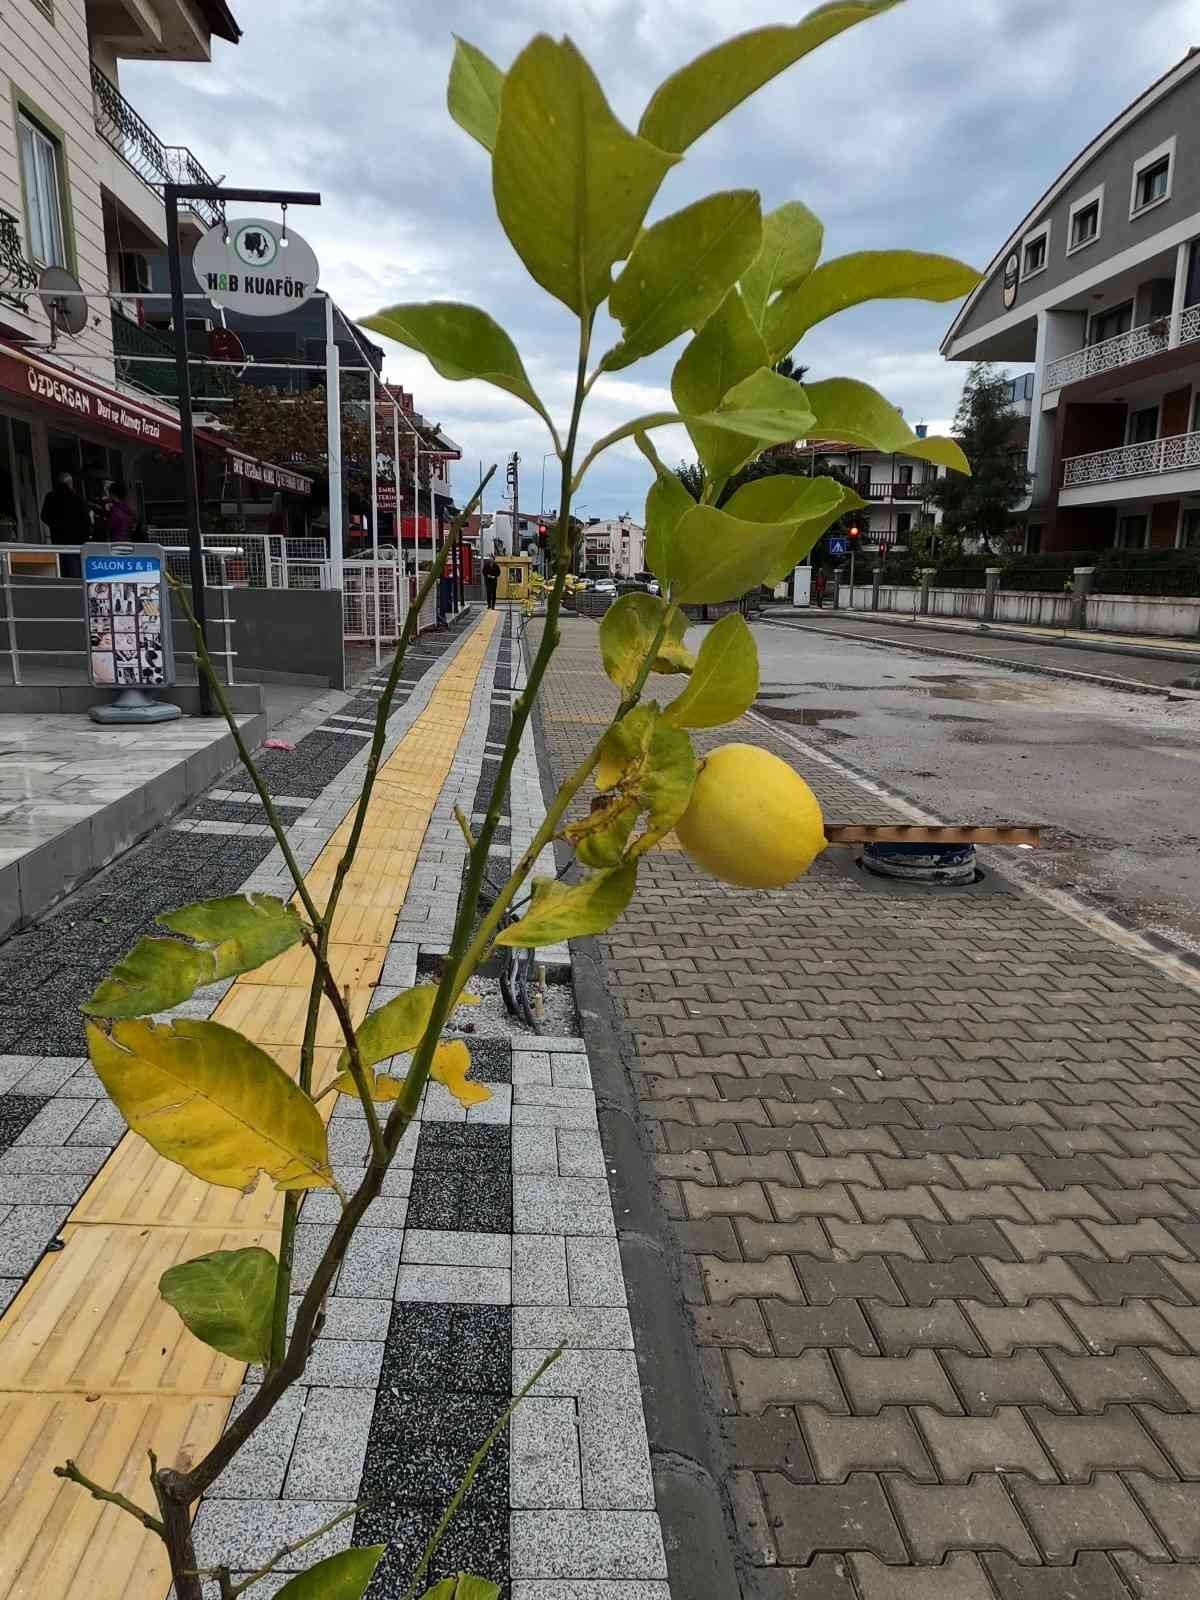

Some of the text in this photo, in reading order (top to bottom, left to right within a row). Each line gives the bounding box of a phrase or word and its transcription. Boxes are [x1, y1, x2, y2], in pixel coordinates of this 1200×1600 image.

[207, 272, 304, 298] H&B KUAFÖR
[28, 366, 91, 414] ÖZDERSAN
[91, 560, 125, 571] SALON
